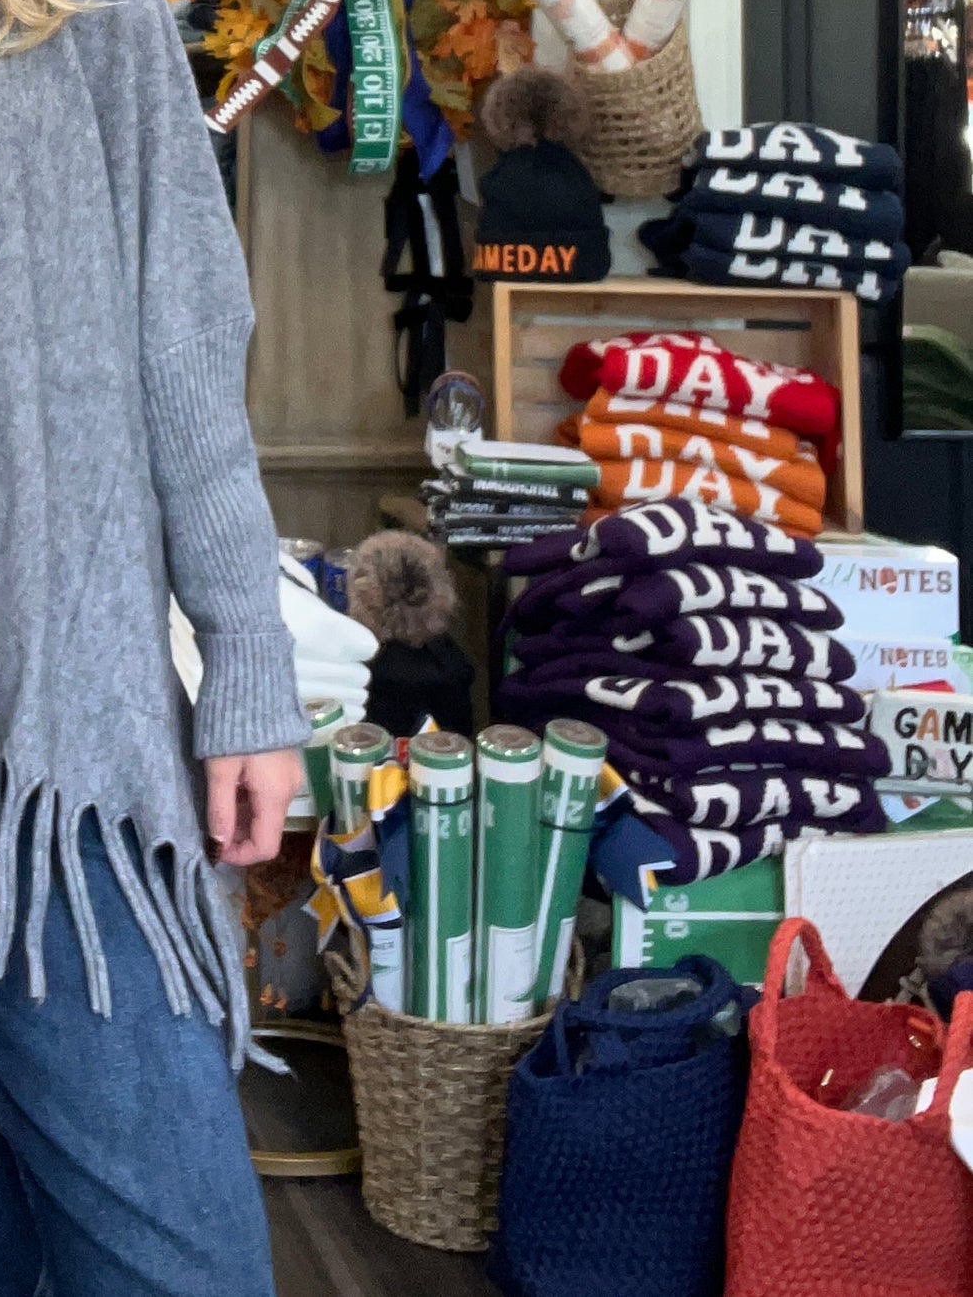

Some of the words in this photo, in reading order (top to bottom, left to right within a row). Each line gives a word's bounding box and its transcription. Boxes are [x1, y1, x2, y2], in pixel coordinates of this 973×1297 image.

[473, 243, 578, 274] AMEDAY
[617, 346, 785, 419] DAY
[895, 706, 973, 745] GAM
